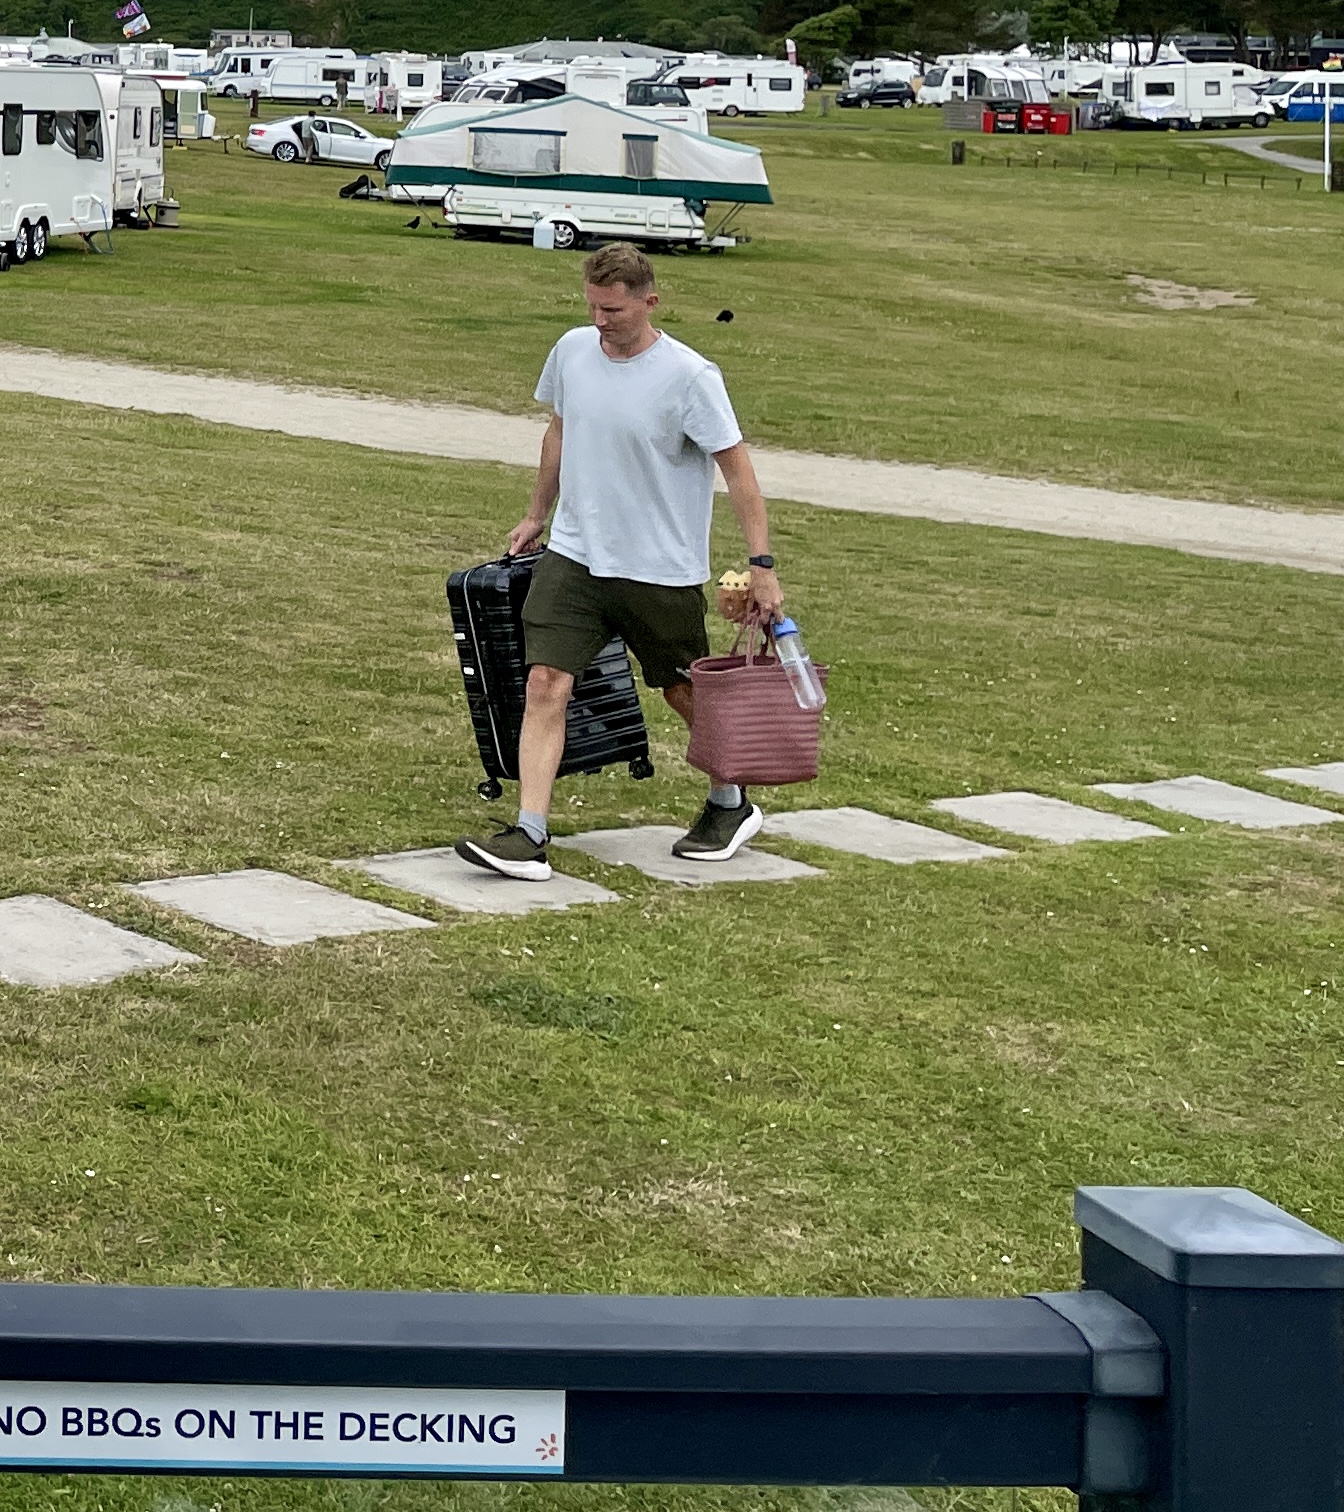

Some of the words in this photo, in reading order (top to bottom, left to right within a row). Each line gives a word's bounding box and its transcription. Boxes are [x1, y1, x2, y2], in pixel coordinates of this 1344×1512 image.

[61, 1407, 161, 1438] BBQs
[174, 1409, 236, 1439] ON
[249, 1410, 325, 1440] THE
[338, 1412, 517, 1444] DECKING
